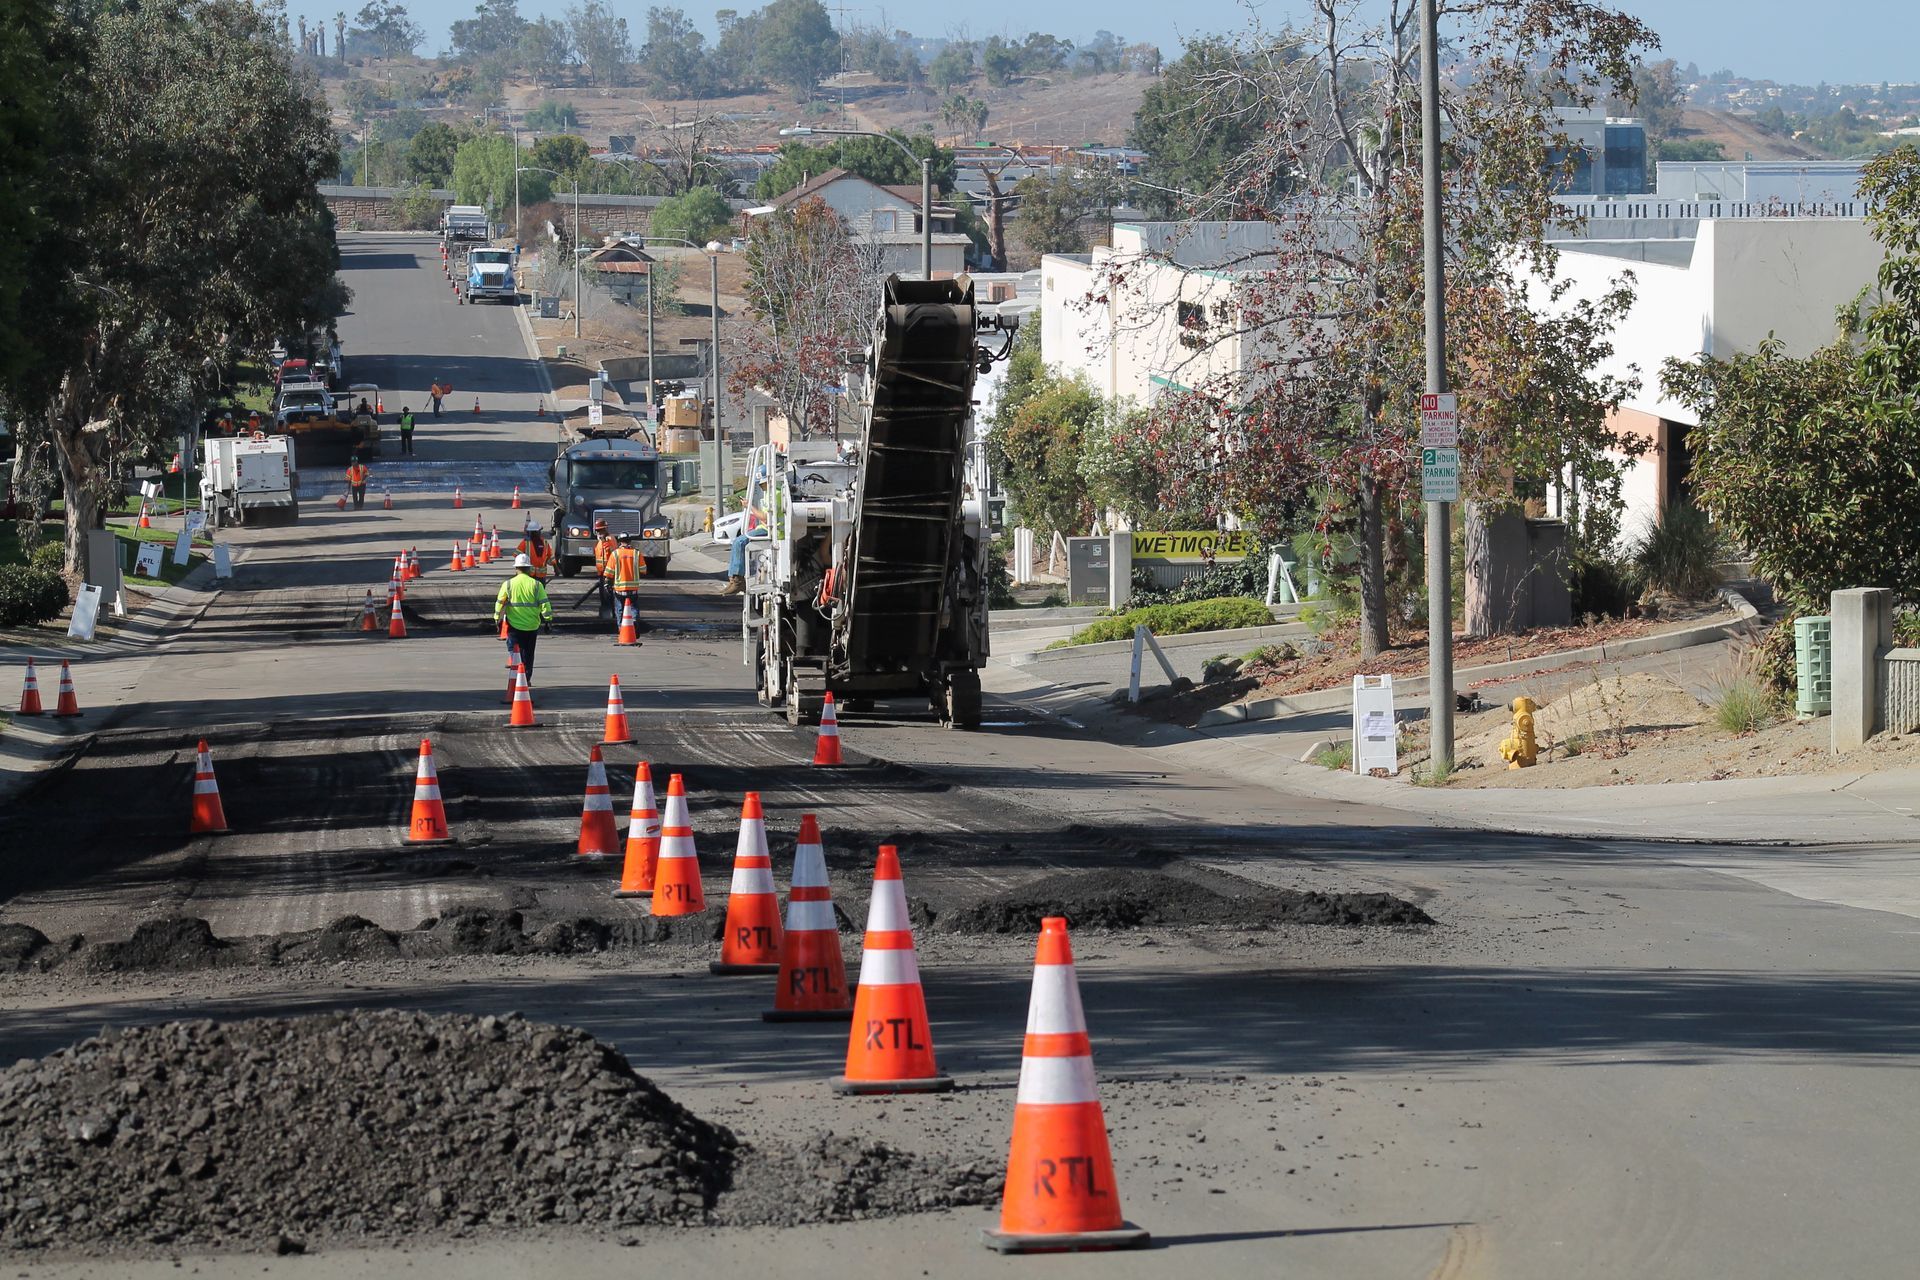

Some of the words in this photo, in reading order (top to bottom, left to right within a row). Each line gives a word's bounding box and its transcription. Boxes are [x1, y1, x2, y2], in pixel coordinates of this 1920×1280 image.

[1423, 397, 1436, 409] NO
[1424, 411, 1455, 420] PARKING
[1425, 451, 1433, 463] 2
[1437, 454, 1455, 463] HOUR
[1425, 468, 1456, 477] PARKING
[143, 557, 154, 565] RTL
[416, 817, 441, 832] RTL
[662, 884, 697, 903] RTL
[737, 926, 777, 950] RTL
[789, 967, 839, 996] RTL
[867, 1018, 923, 1050] RTL
[1034, 1156, 1108, 1199] RTL
